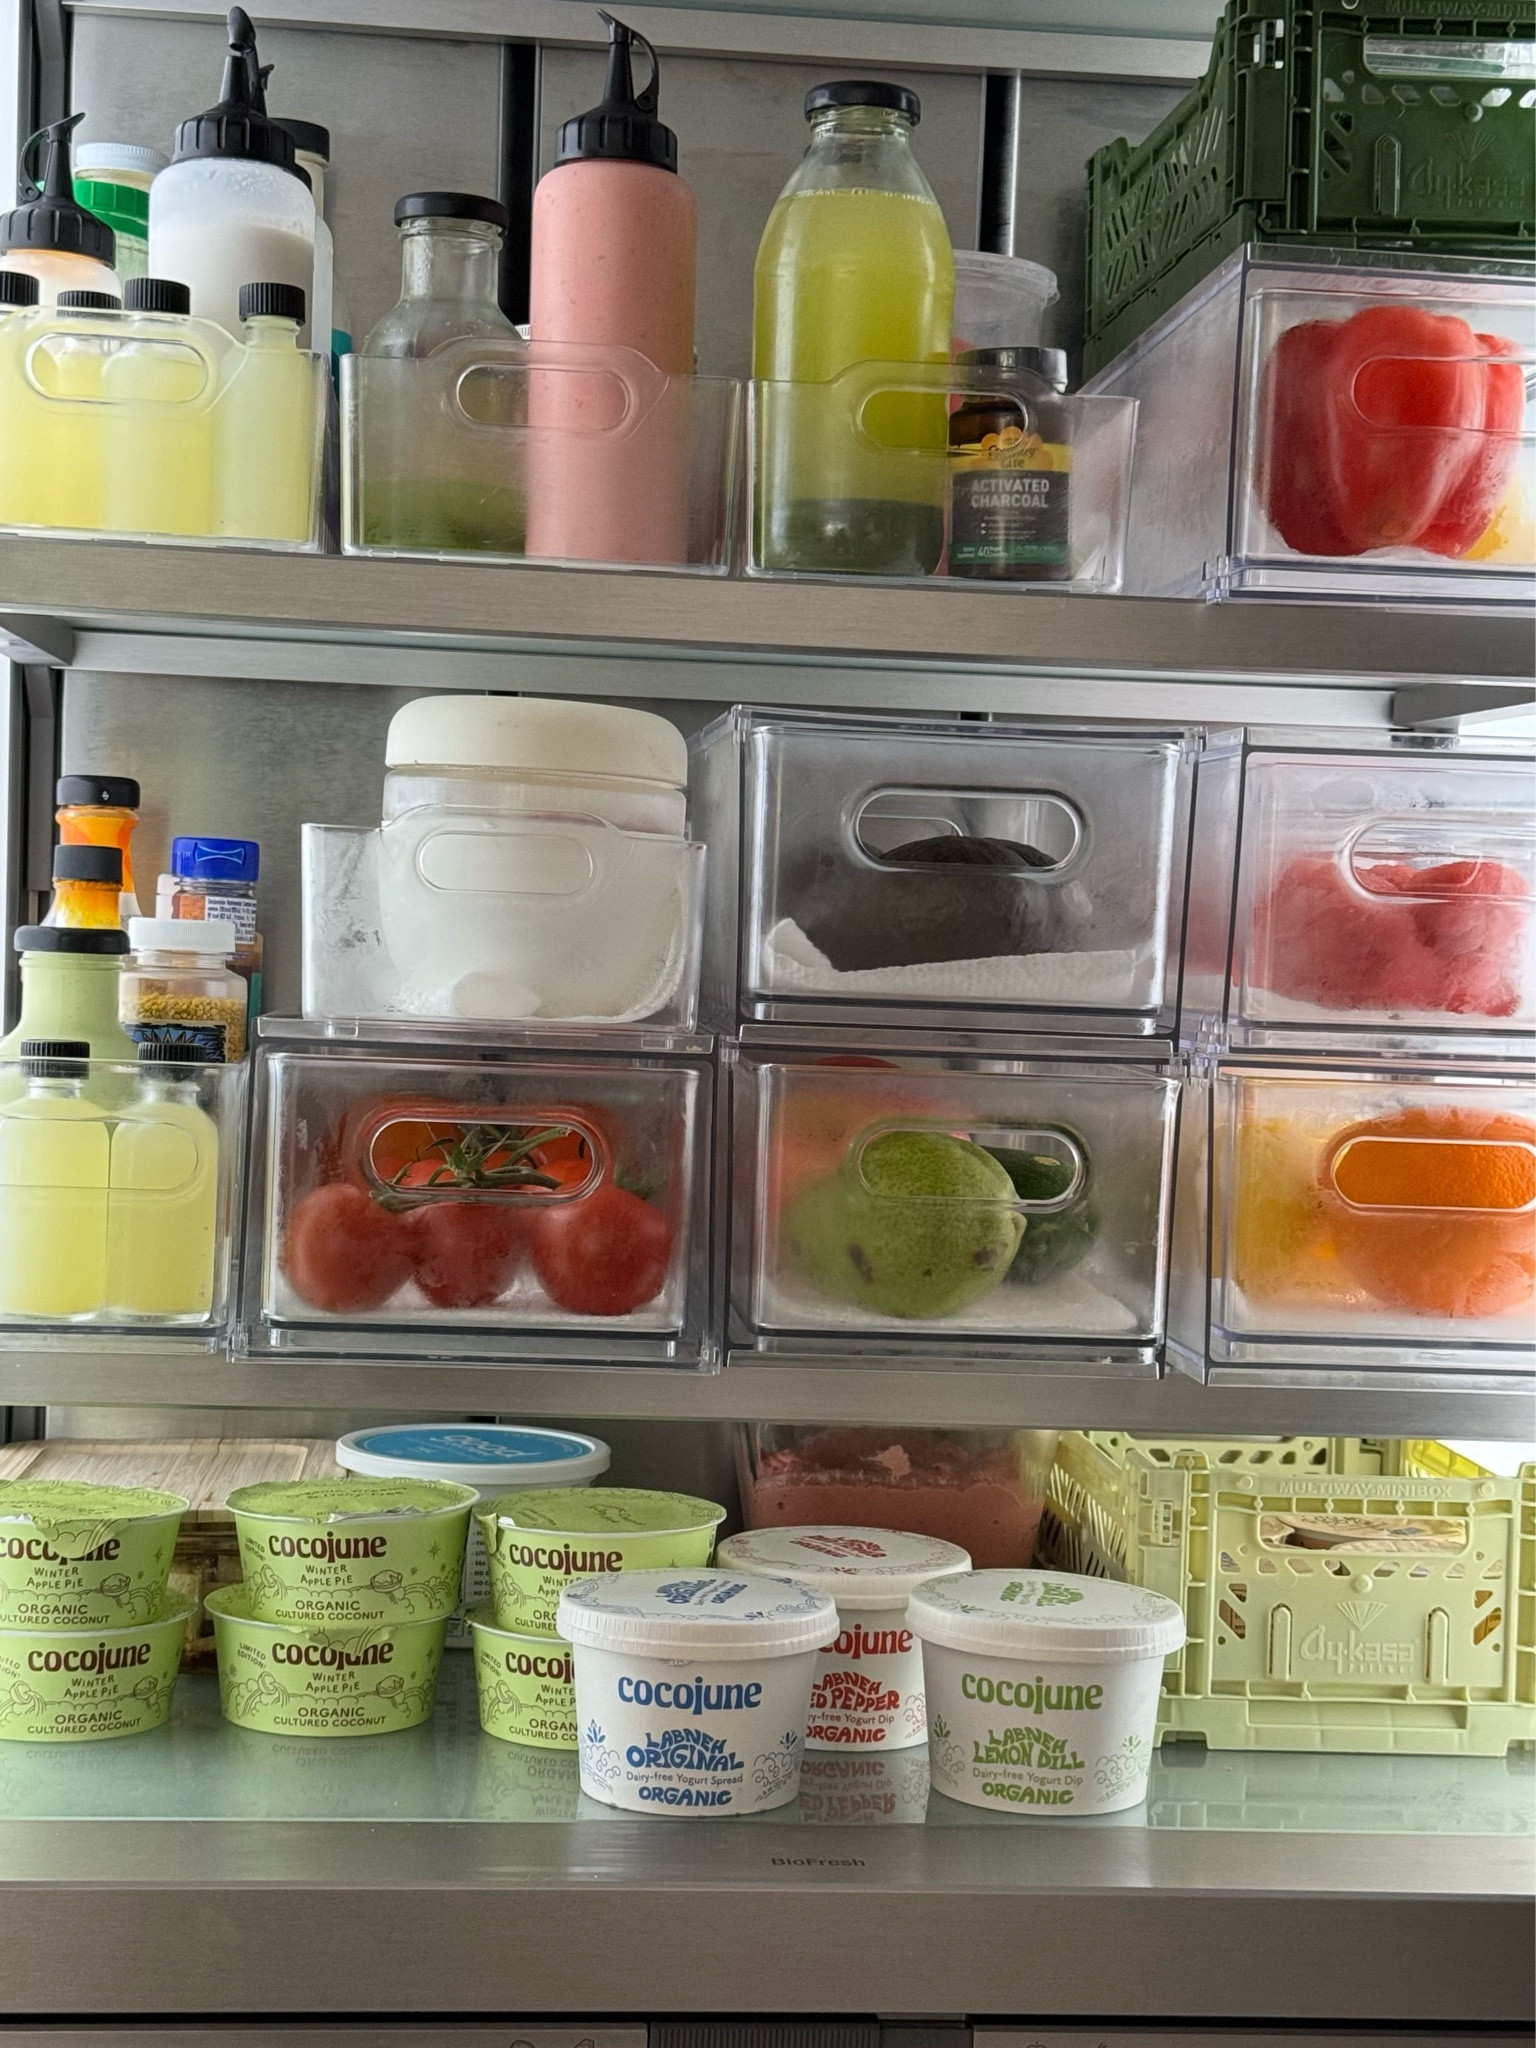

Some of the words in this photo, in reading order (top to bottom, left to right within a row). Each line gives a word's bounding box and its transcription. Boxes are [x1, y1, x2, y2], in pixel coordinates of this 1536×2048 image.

[971, 478, 1050, 493] ACTIVATED
[971, 494, 1049, 508] CHARCOAL
[268, 1531, 388, 1564] cocojune
[508, 1543, 624, 1576] cocojune
[34, 1566, 80, 1578] WINTER
[305, 1564, 349, 1576] WINTER
[538, 1585, 561, 1597] APPL
[17, 1603, 89, 1615] ORGANIC
[294, 1600, 361, 1611] ORGANIC
[0, 1614, 51, 1624] ULTURED
[53, 1614, 111, 1625] COCONUT
[275, 1609, 325, 1621] CULTURED
[327, 1610, 385, 1621] COCONUT
[27, 1642, 152, 1675] cocojune
[505, 1651, 575, 1684] cocoj
[71, 1674, 115, 1687] WINTER
[312, 1671, 356, 1683] WINTER
[540, 1683, 574, 1696] WINTE
[618, 1676, 762, 1715] cocojune
[961, 1673, 1104, 1715] cocojune
[831, 1685, 900, 1713] PEPPER
[54, 1709, 123, 1725] ORGANIC
[297, 1706, 365, 1718] ORGANIC
[843, 1712, 876, 1726] Yogurt
[878, 1713, 895, 1726] Dip
[27, 1725, 87, 1734] CULTURED
[90, 1717, 142, 1733] COCONUT
[273, 1716, 329, 1728] CULTURED
[331, 1716, 387, 1728] COCONUT
[528, 1717, 577, 1732] ORGAN
[508, 1725, 559, 1740] CULTURED
[988, 1726, 1069, 1754] LABNEH
[645, 1727, 727, 1754] LABNEH
[626, 1744, 745, 1771] ORIGINAL
[972, 1740, 1034, 1767] LEMON
[1037, 1751, 1086, 1770] DILL
[626, 1771, 673, 1782] Dairy-free
[676, 1774, 709, 1786] Yogurt
[710, 1773, 744, 1788] Spread
[972, 1767, 1024, 1781] Dairy-free
[1027, 1771, 1062, 1786] Yogurt
[1064, 1774, 1084, 1787] Dip
[638, 1786, 733, 1807] ORGANIC
[981, 1782, 1075, 1805] ORGANIC
[771, 1857, 867, 1867] BioFresh
